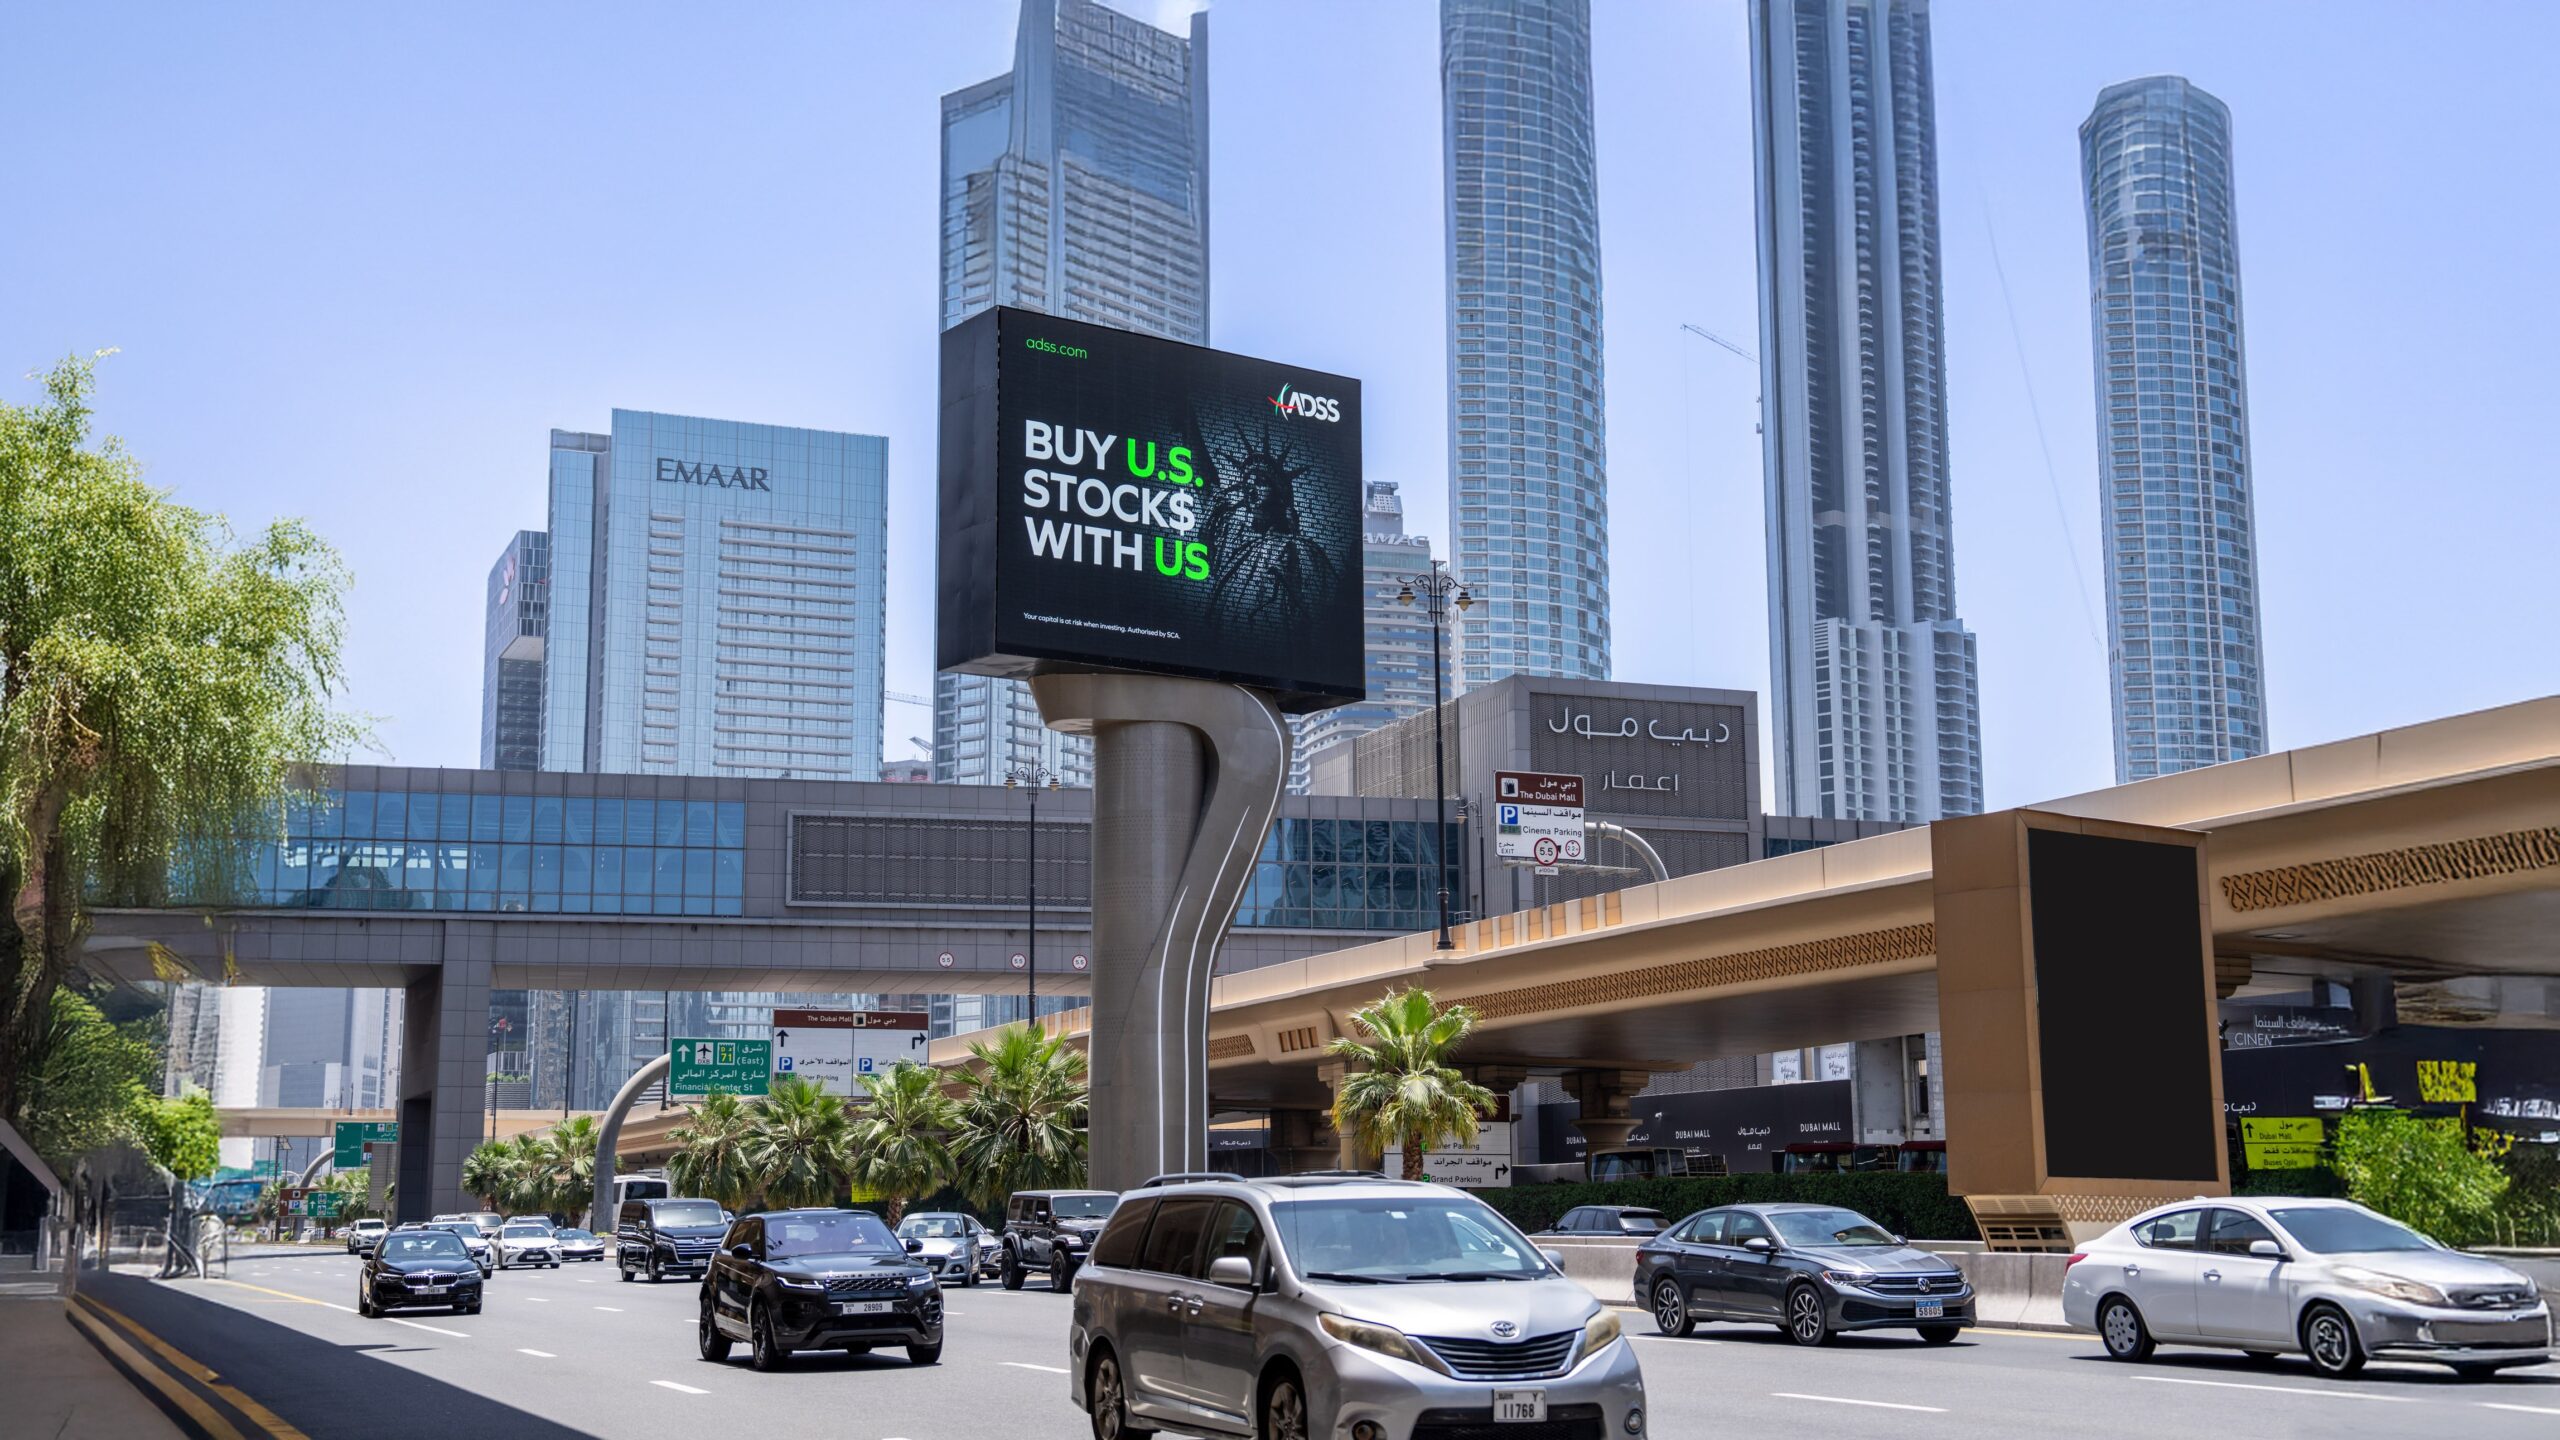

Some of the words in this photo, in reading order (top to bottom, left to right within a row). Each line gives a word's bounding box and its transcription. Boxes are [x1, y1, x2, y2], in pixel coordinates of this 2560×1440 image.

[1026, 338, 1087, 359] adss.com
[1286, 391, 1341, 423] ADSS
[1025, 419, 1118, 470] BUY
[1127, 437, 1204, 488] U.S.
[656, 457, 771, 492] EMAAR
[1024, 468, 1196, 537] STOCK$
[1363, 532, 1429, 548] AMAC
[1024, 516, 1143, 572] WITH
[1155, 536, 1210, 580] US
[1023, 612, 1038, 620] Your
[1038, 614, 1058, 623] capital
[1100, 623, 1127, 633] investing.
[1128, 627, 1159, 636] Authorised
[1159, 630, 1166, 638] by
[1167, 632, 1181, 640] SCA.
[1548, 706, 1638, 740] مول
[1649, 720, 1730, 748] دبي
[1540, 778, 1558, 788] مول
[1560, 780, 1576, 791] دبي
[1602, 770, 1679, 796] إعمار
[1520, 790, 1534, 799] The
[1535, 791, 1558, 800] Dubai
[1560, 793, 1576, 802] Mall
[1522, 806, 1551, 817] السينما
[1554, 808, 1581, 819] مواقف
[1522, 826, 1551, 834] Cinema
[1554, 828, 1582, 837] Parking
[1540, 847, 1553, 856] 5.5
[2234, 1033, 2273, 1046] CINEM
[721, 1054, 733, 1062] 71
[737, 1057, 764, 1066] (East)
[678, 1069, 705, 1081] المالي
[709, 1069, 737, 1080] المركز
[741, 1070, 766, 1080] شارع
[1738, 1127, 1755, 1136] مول
[1755, 1127, 1771, 1136] دبي
[1800, 1123, 1820, 1132] DUBAI
[1822, 1122, 1841, 1131] MALL
[1675, 1130, 1693, 1139] DUBAI
[1694, 1130, 1710, 1138] MALL
[1533, 1392, 1538, 1402] Y
[1504, 1404, 1534, 1418] 11768
